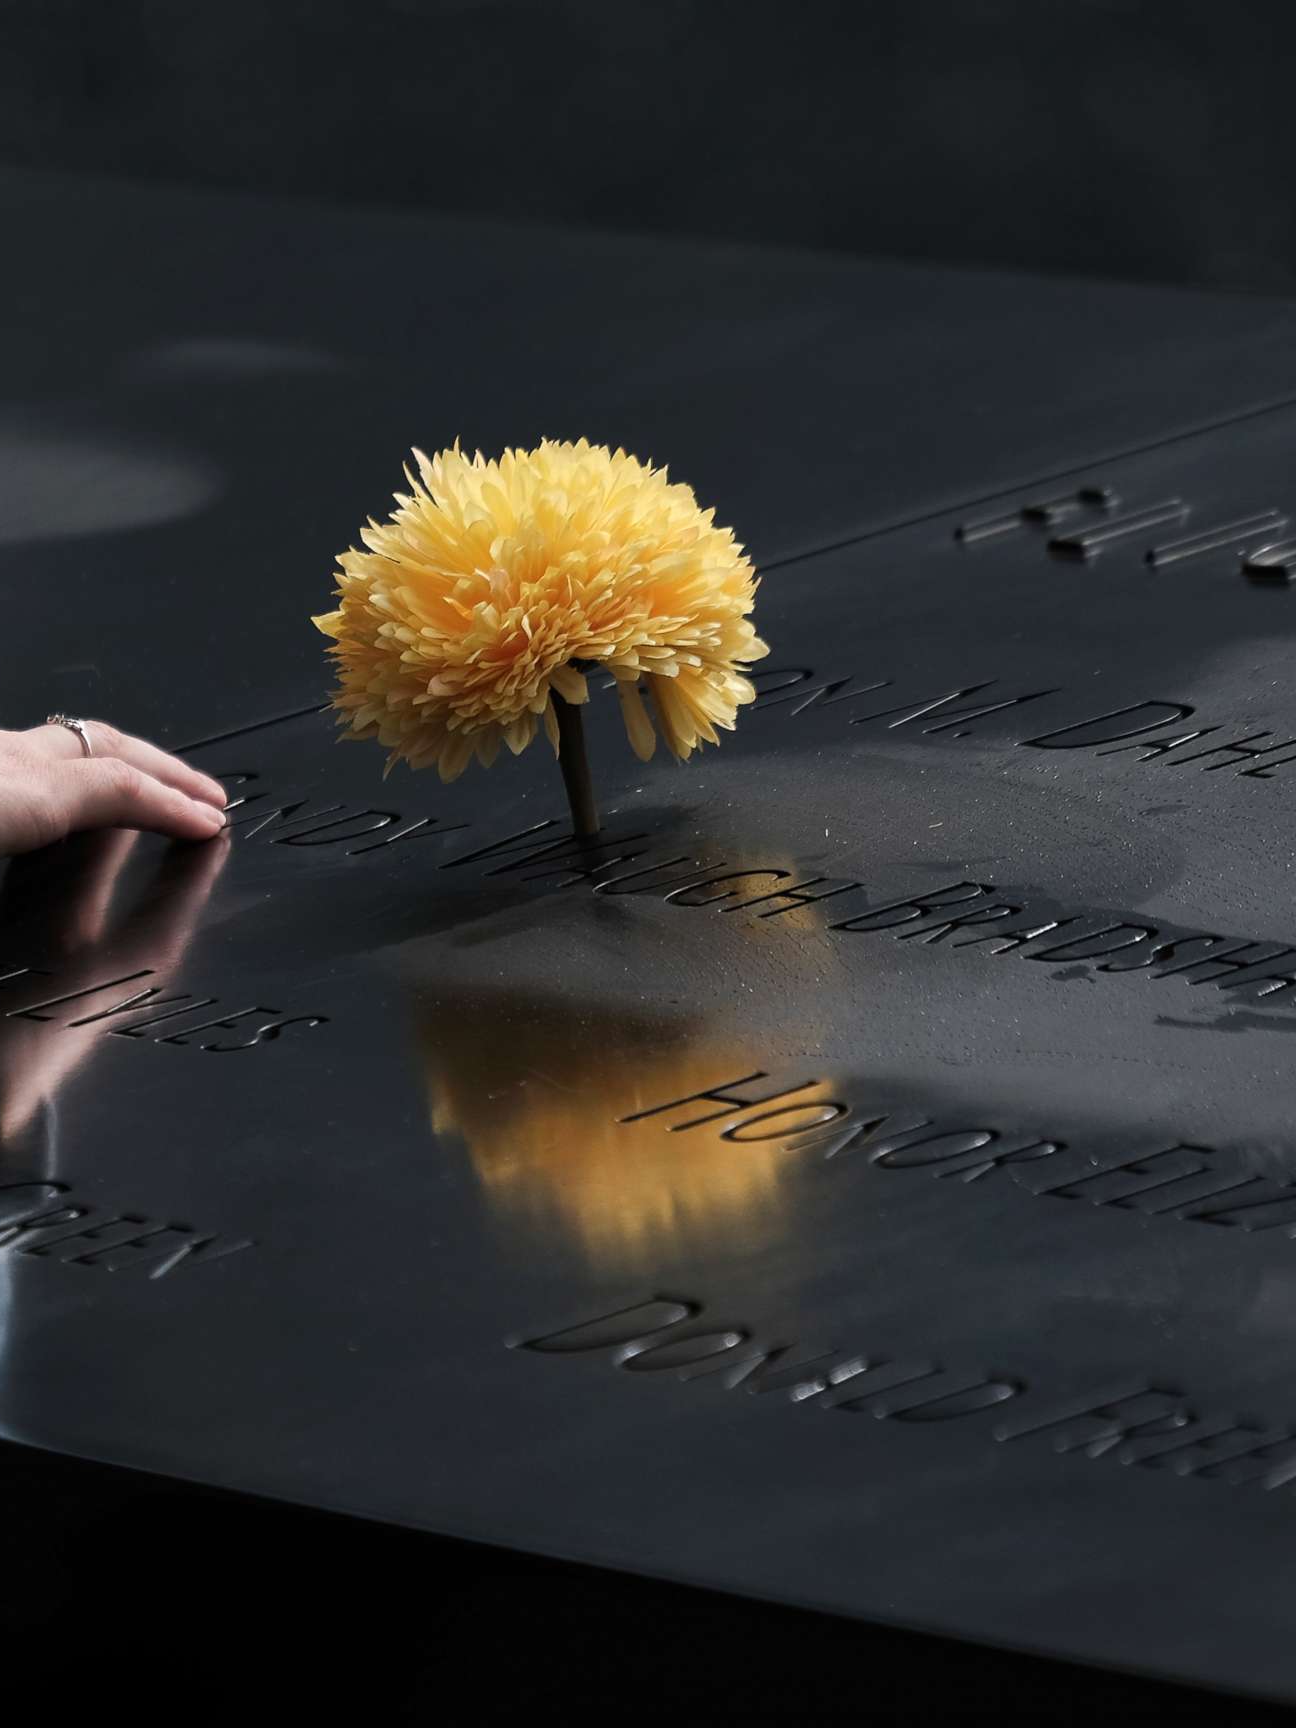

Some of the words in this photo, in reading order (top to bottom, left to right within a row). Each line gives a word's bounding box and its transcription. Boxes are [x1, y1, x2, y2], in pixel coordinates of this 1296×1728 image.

[850, 680, 1062, 738] M.
[437, 816, 865, 918] WAUGH
[5, 969, 330, 1052] LYLES
[613, 1072, 1067, 1183] HONOR
[505, 1296, 1027, 1421] DONALD
